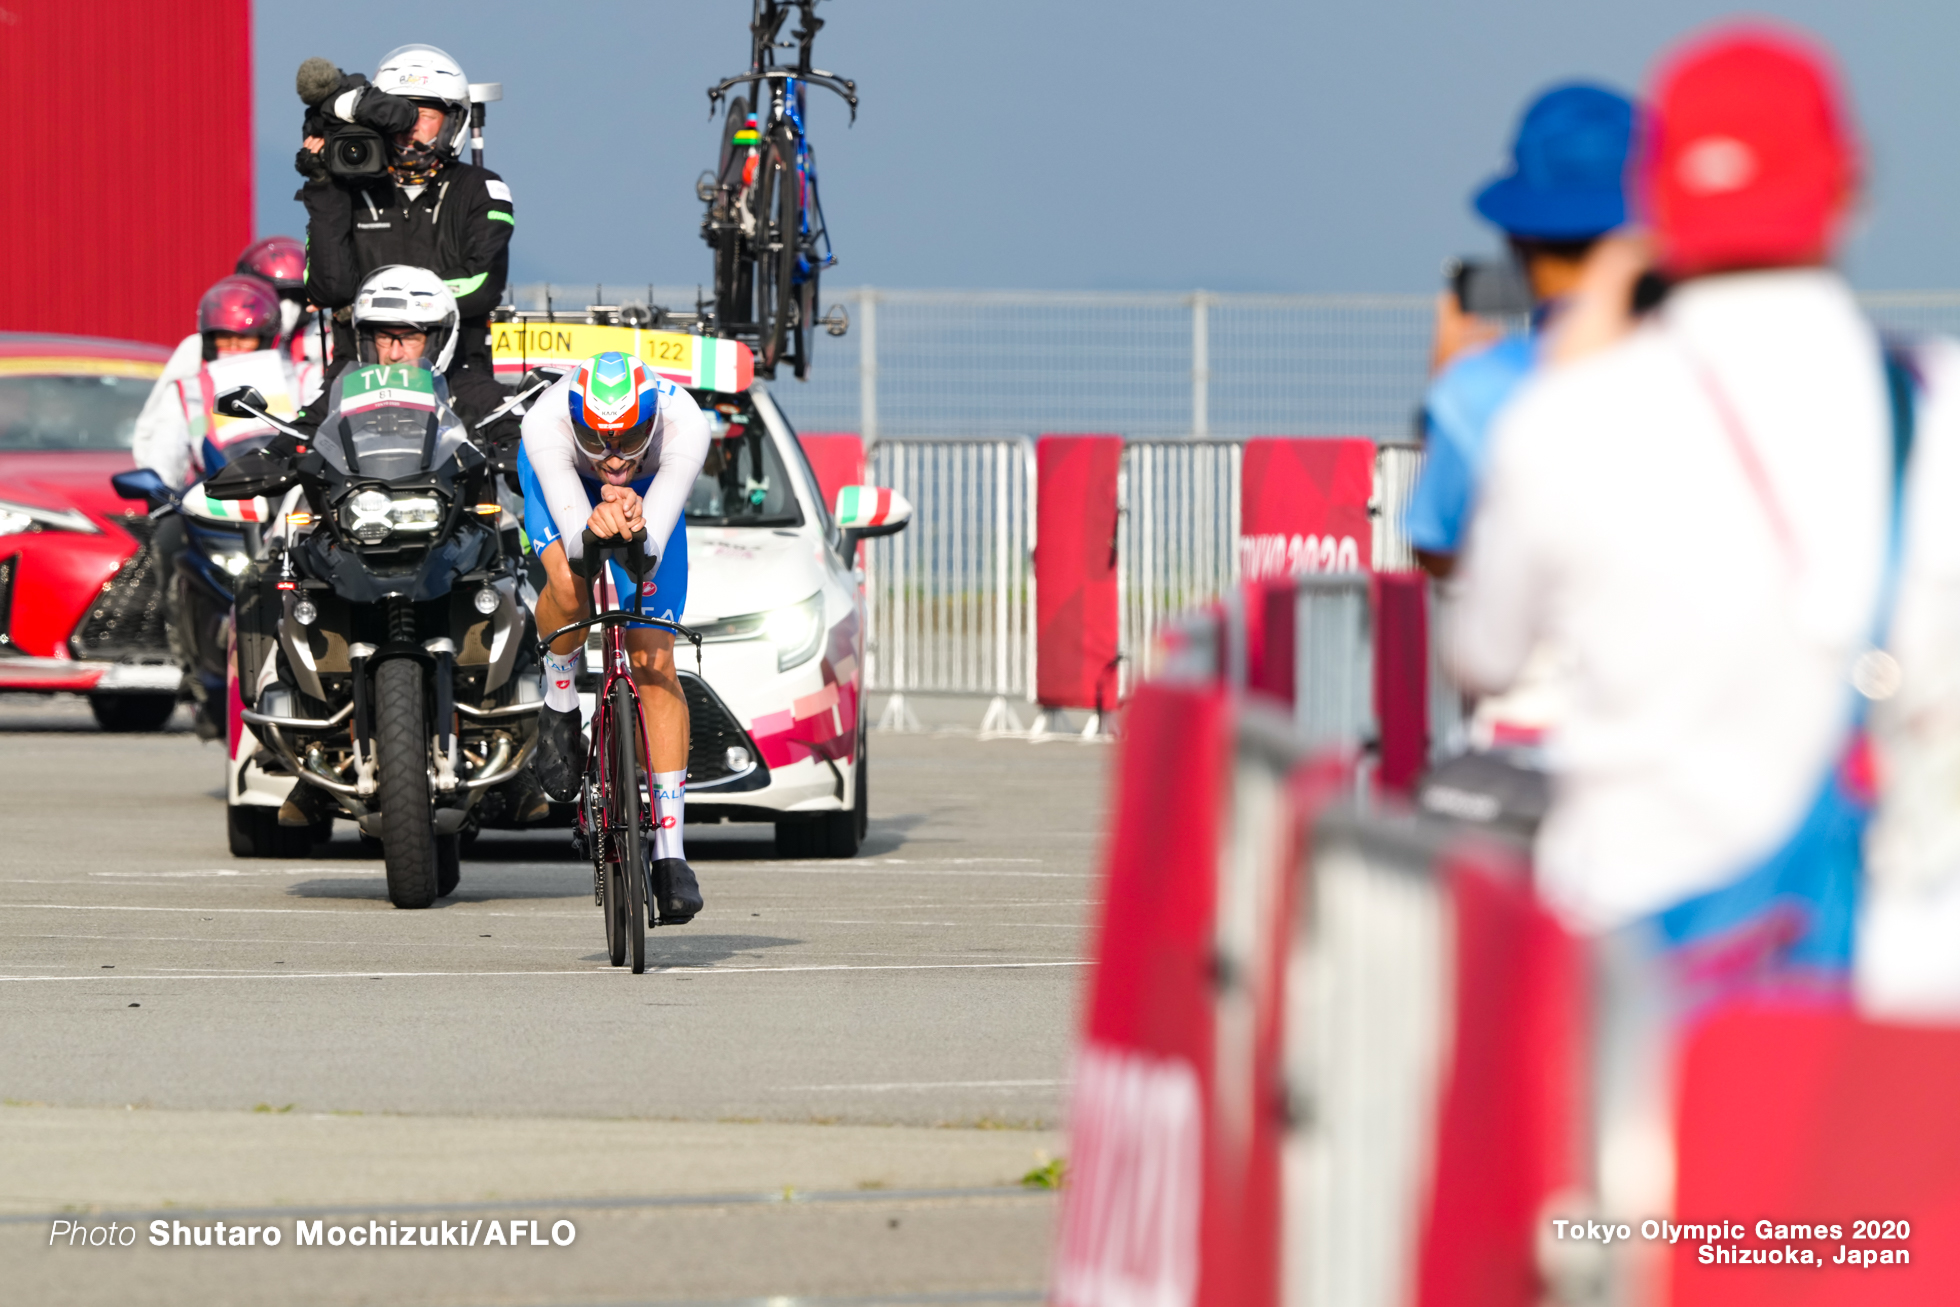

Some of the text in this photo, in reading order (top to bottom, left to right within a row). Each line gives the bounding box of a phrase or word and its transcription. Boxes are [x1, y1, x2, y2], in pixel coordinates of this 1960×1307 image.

[648, 339, 684, 362] 122
[360, 365, 409, 390] TV 1
